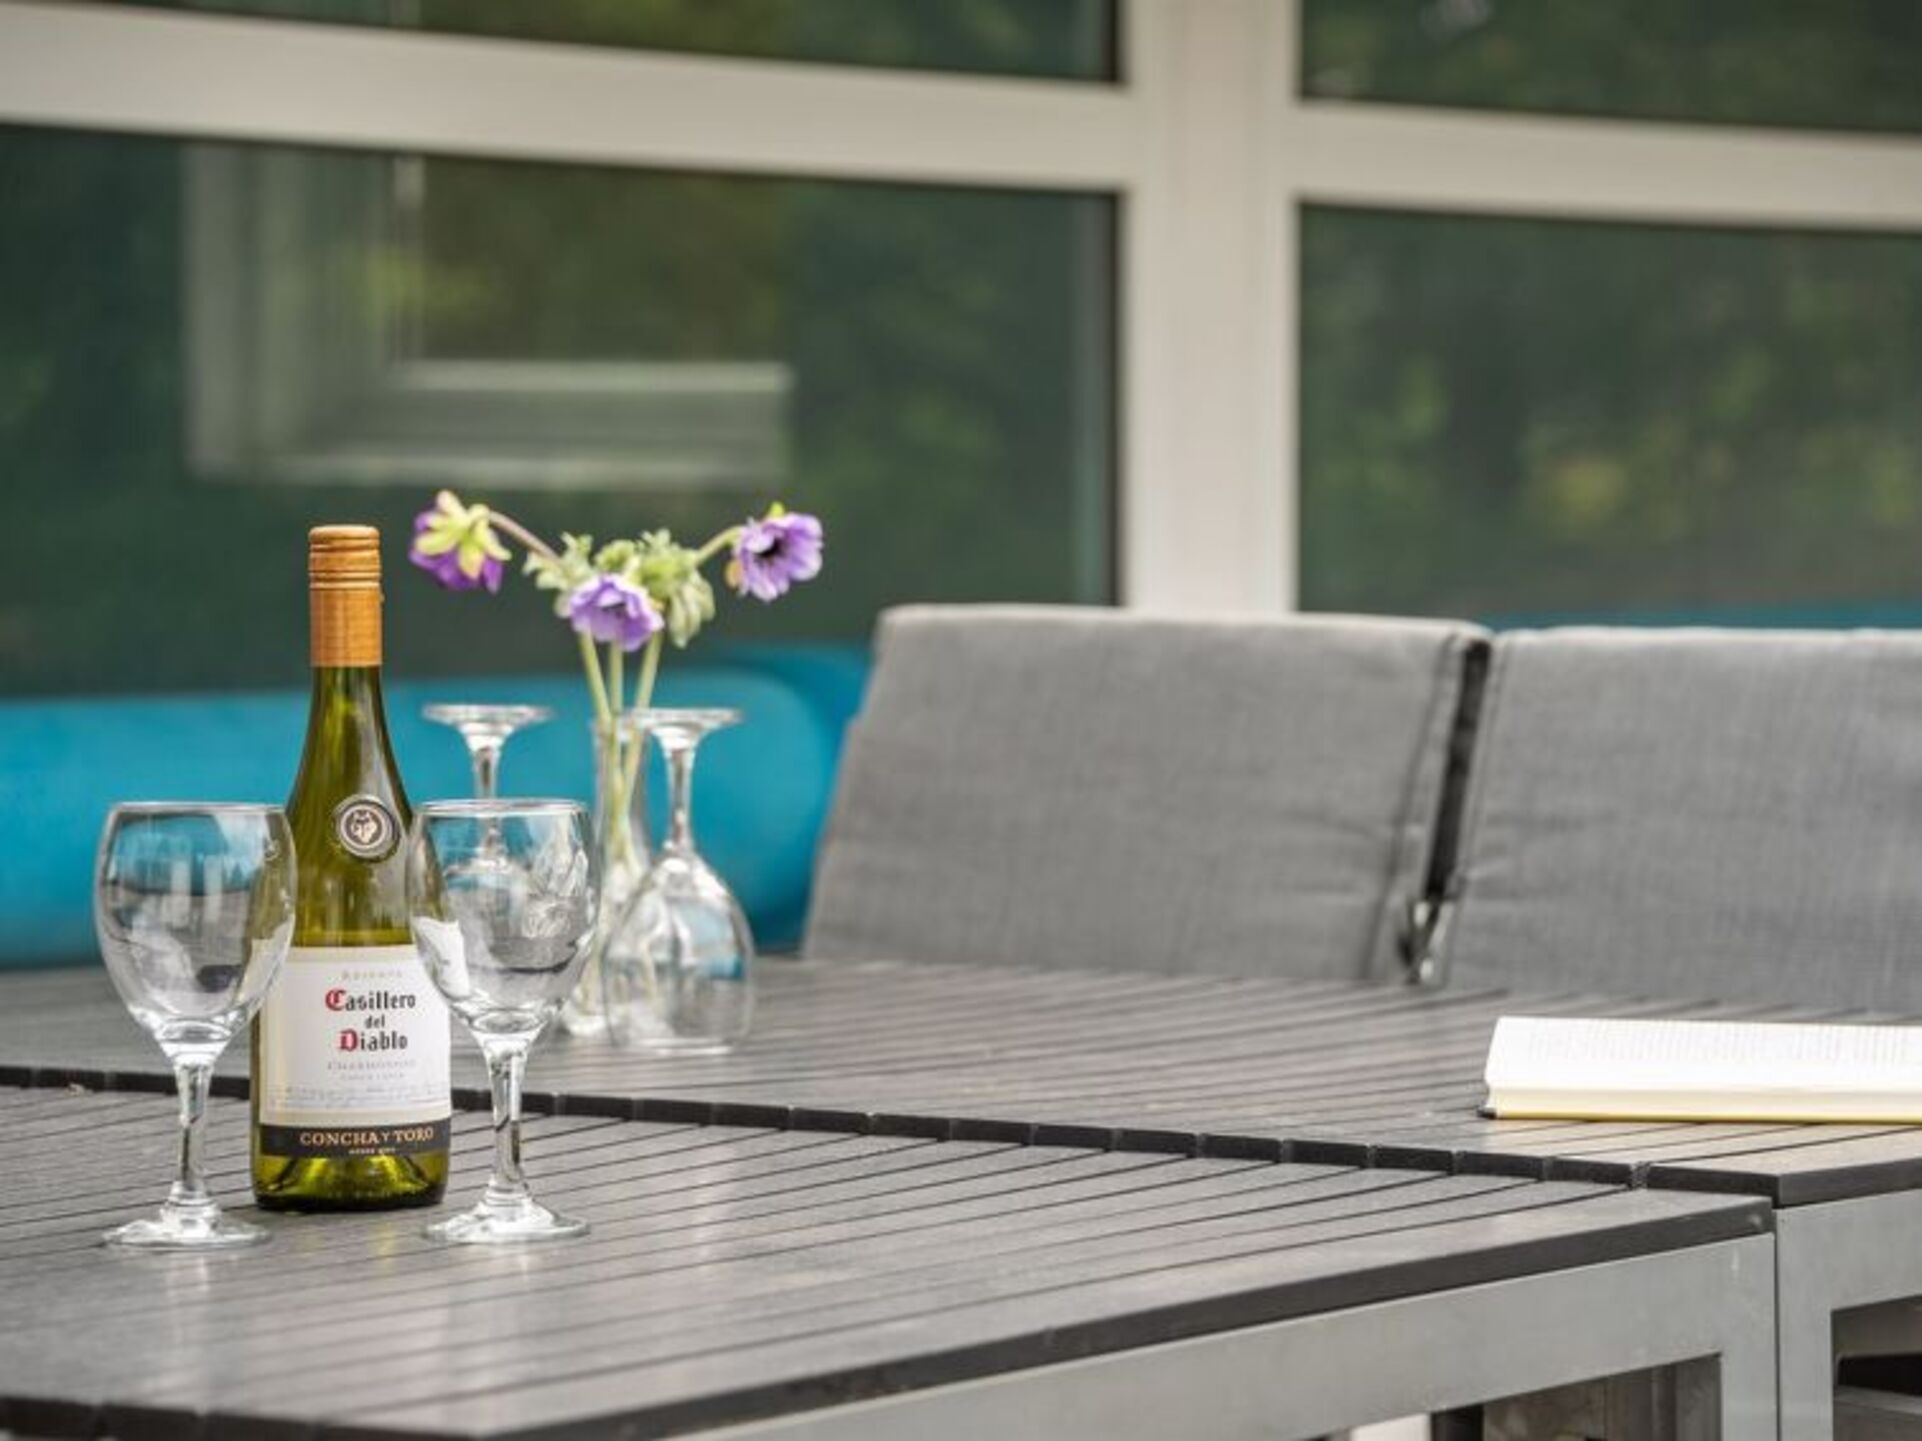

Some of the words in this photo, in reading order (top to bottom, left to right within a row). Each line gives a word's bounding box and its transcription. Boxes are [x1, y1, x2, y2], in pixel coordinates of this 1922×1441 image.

[325, 989, 416, 1011] Casillero
[364, 1014, 385, 1029] del
[339, 1029, 408, 1051] Diablo
[299, 1131, 380, 1147] CONCHA
[381, 1132, 390, 1142] Y
[391, 1126, 434, 1142] TORO
